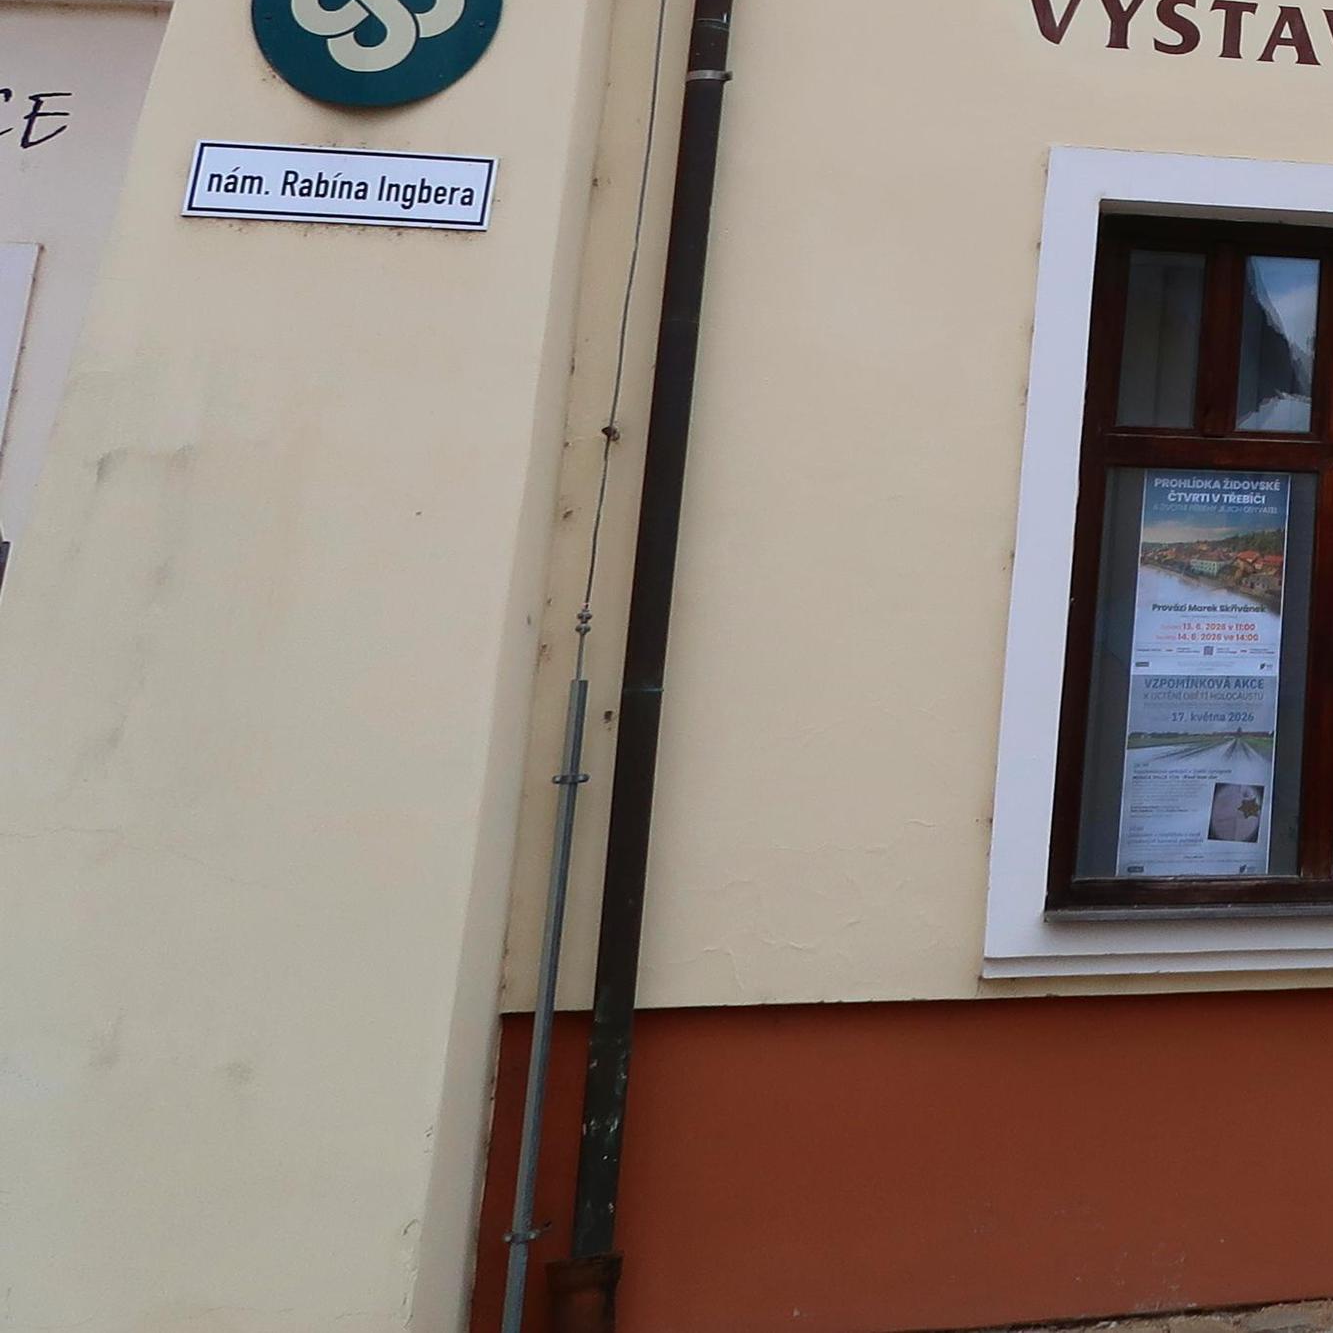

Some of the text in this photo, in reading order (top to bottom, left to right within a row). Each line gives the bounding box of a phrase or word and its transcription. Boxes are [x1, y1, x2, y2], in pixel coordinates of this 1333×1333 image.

[206, 166, 474, 210] nám. Rabína Ingbera
[1154, 476, 1281, 491] PROHLÍDKA ŽIDOVSKÉ
[1167, 490, 1266, 504] ČTVRTI V TŘEBÍČI
[1188, 604, 1218, 612] Marek
[1144, 676, 1264, 689] VZPOMÍNKOVÁ AKCE
[1190, 711, 1226, 722] května
[1228, 712, 1255, 722] 2026
